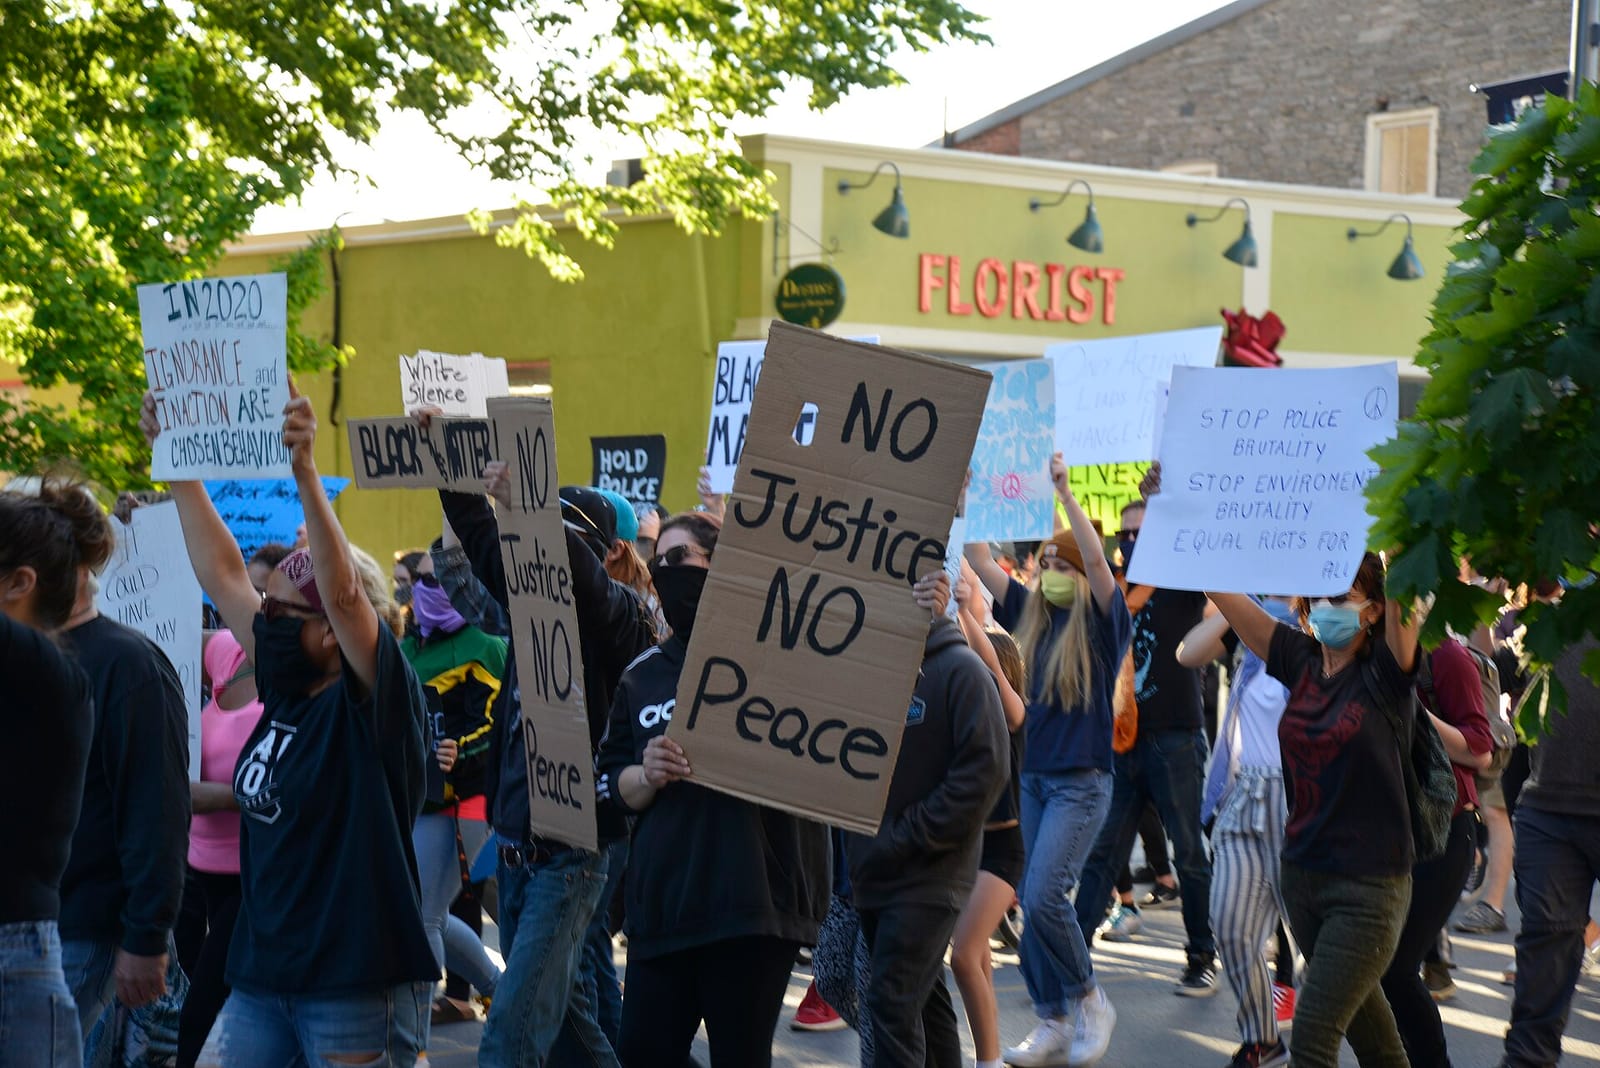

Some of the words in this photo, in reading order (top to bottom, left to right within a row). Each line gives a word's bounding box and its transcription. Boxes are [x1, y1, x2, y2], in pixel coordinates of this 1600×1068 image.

[918, 252, 1125, 325] FLORIST
[144, 339, 245, 392] IGNORANCE
[255, 358, 278, 386] and
[402, 355, 467, 383] White
[156, 389, 231, 431] INACTION
[237, 387, 275, 425] ARE
[405, 382, 467, 405] Silence
[1200, 408, 1269, 429] STOP
[1283, 402, 1342, 429] POLICE
[841, 381, 938, 463] NO
[358, 423, 423, 479] BLACK
[516, 426, 549, 515] NO
[599, 448, 648, 473] HOLD
[1233, 436, 1327, 463] BRUTALITY
[599, 473, 659, 500] POLICE
[1188, 472, 1245, 493] STOP
[734, 468, 947, 587] Justice
[1216, 497, 1313, 520] BRUTALITY
[1173, 529, 1242, 554] EQUAL
[1317, 530, 1349, 552] FOR
[500, 533, 572, 605] Justice
[1321, 560, 1349, 579] ALL
[155, 618, 176, 643] MY
[756, 566, 866, 656] NO
[530, 617, 572, 703] NO
[686, 656, 888, 780] Peace
[525, 717, 582, 811] Peace
